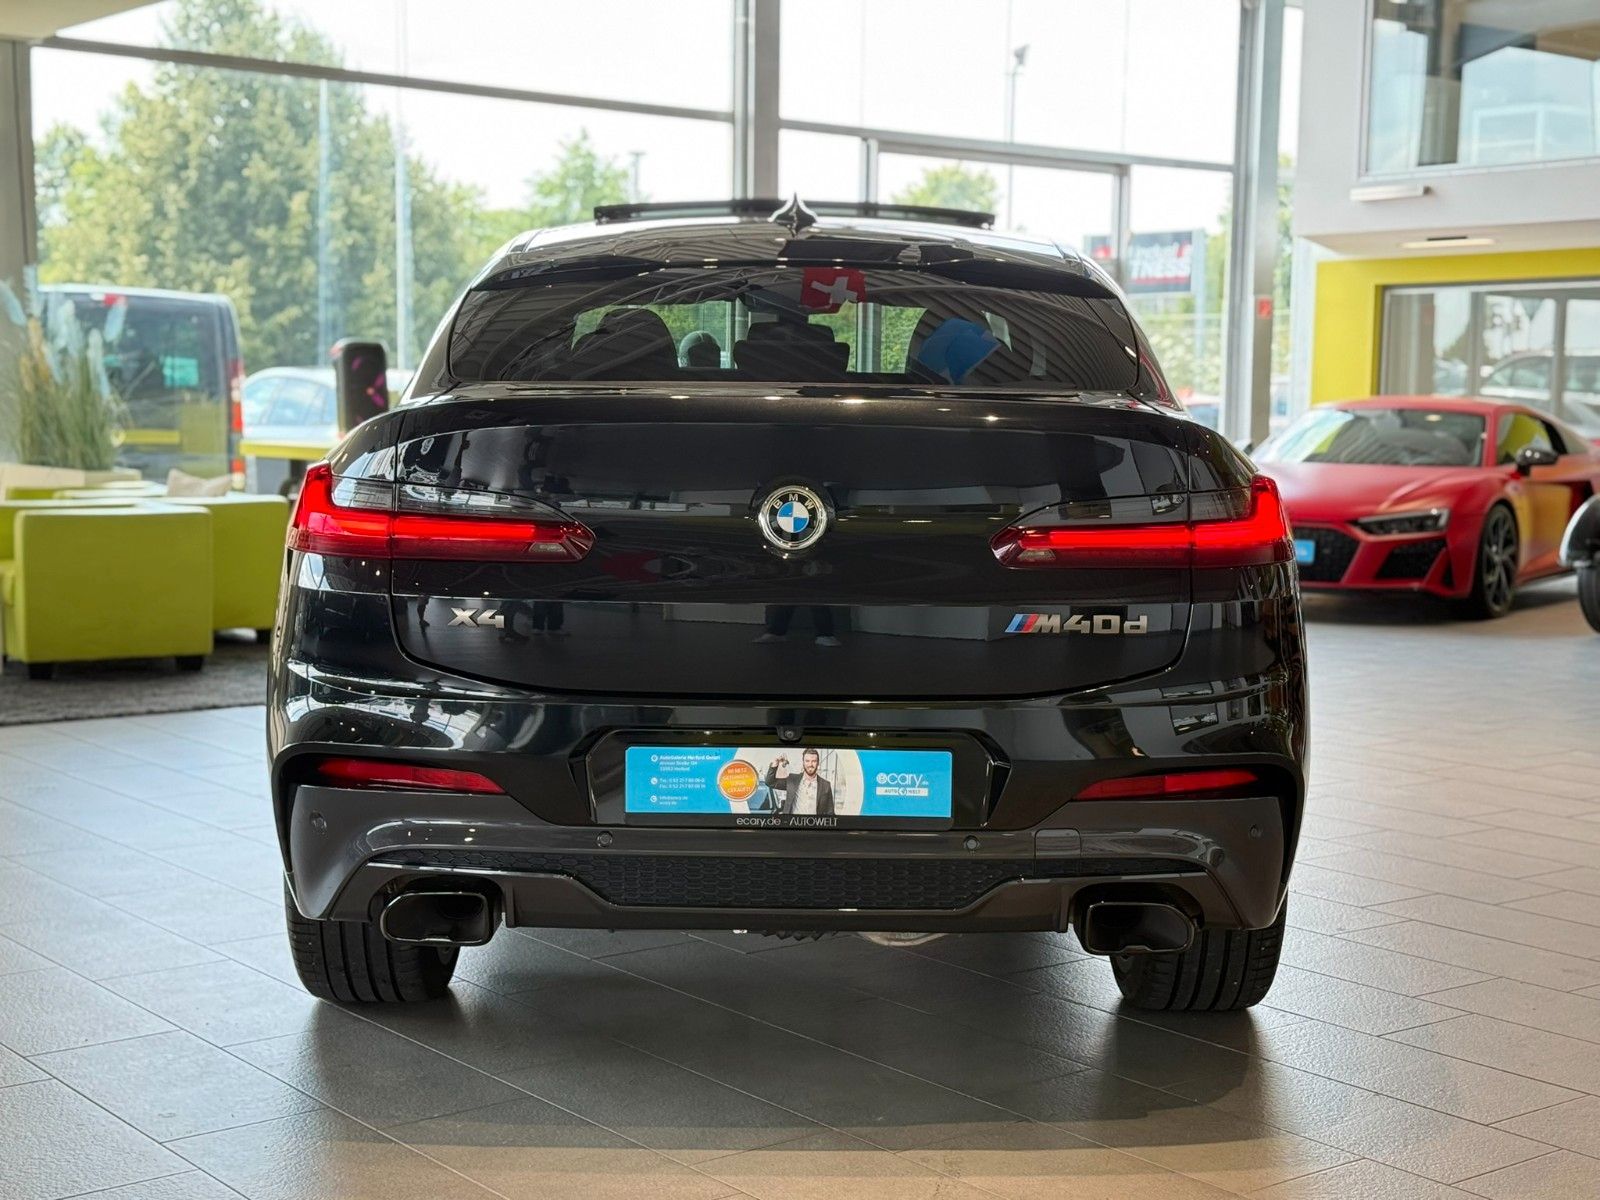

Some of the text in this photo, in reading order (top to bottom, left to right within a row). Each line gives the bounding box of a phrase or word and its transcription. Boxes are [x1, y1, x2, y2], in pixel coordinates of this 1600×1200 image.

[772, 493, 815, 509] BMW
[447, 607, 505, 629] X4
[1030, 613, 1148, 634] M40d
[736, 816, 782, 828] ecary.de
[789, 816, 838, 827] AUTOWELT
